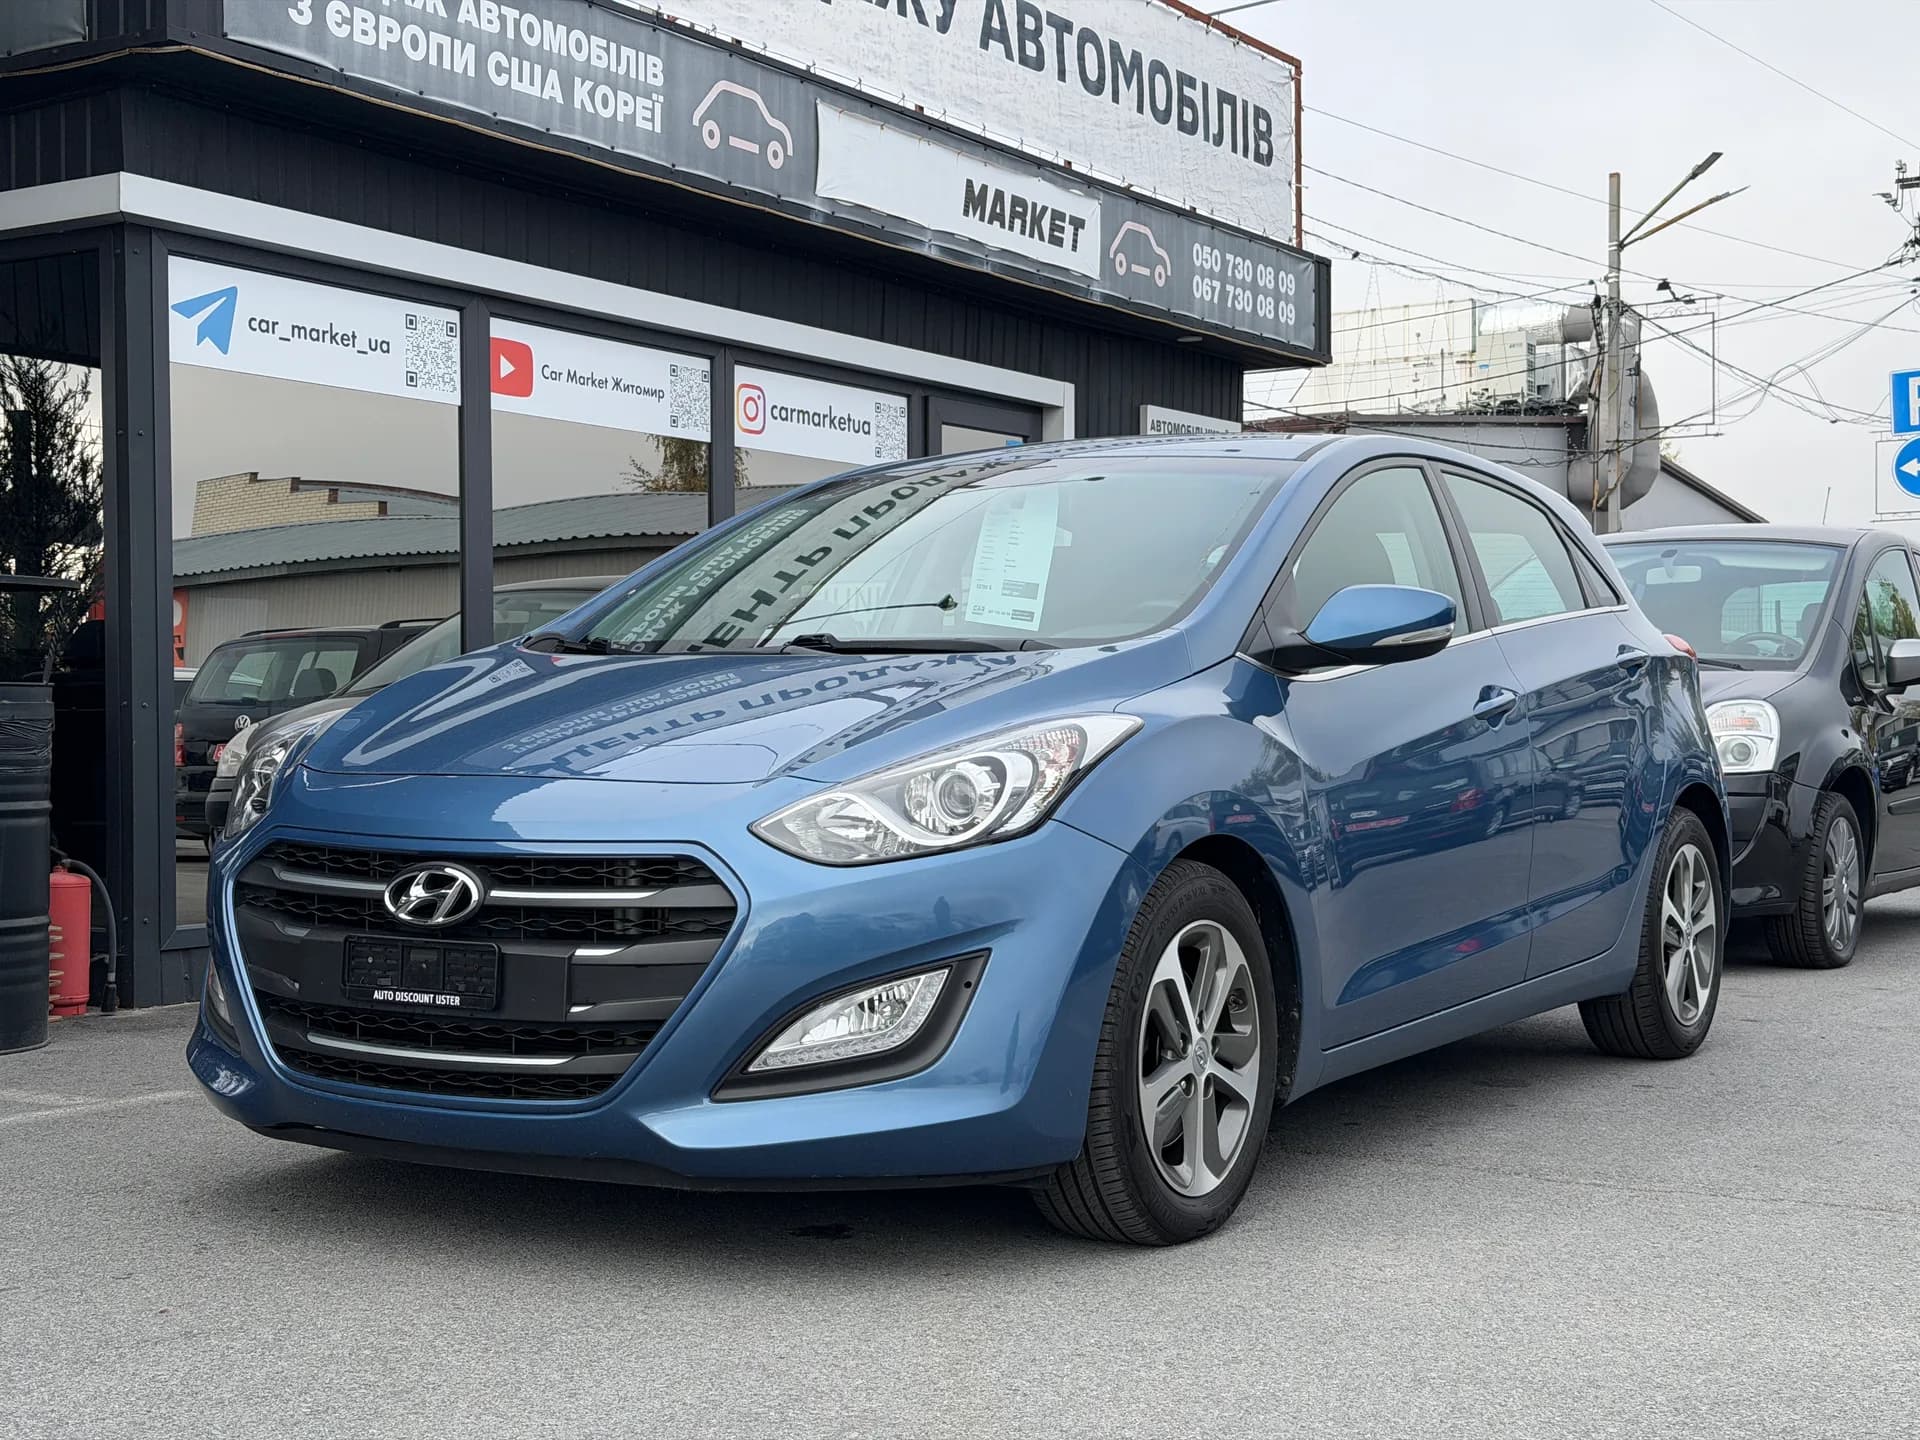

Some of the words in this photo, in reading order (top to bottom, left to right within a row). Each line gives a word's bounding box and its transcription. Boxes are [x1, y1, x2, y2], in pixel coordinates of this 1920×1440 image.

[326, 0, 476, 78] ЄВРОПИ
[488, 51, 565, 105] США
[574, 76, 664, 133] КОРЕЇ
[457, 0, 664, 87] АВТОМОБІЛІВ
[979, 0, 1275, 167] АВТОМОБІЛІВ
[962, 178, 1086, 253] MARKET
[1193, 243, 1221, 273] 050
[1226, 253, 1253, 282] 730
[1257, 264, 1275, 289] 08
[1279, 270, 1295, 296] 09
[1193, 275, 1221, 304] 067
[1226, 284, 1253, 313] 730
[1257, 294, 1275, 319] 08
[1279, 301, 1295, 325] 09
[248, 316, 391, 354] car_market_ua
[541, 364, 563, 382] Car
[566, 369, 609, 390] Market
[611, 376, 665, 403] Житомир
[771, 403, 872, 435] carmarketua
[373, 989, 394, 1001] AUTO
[395, 991, 434, 1004] DISCOUNT
[435, 994, 460, 1006] USTER
